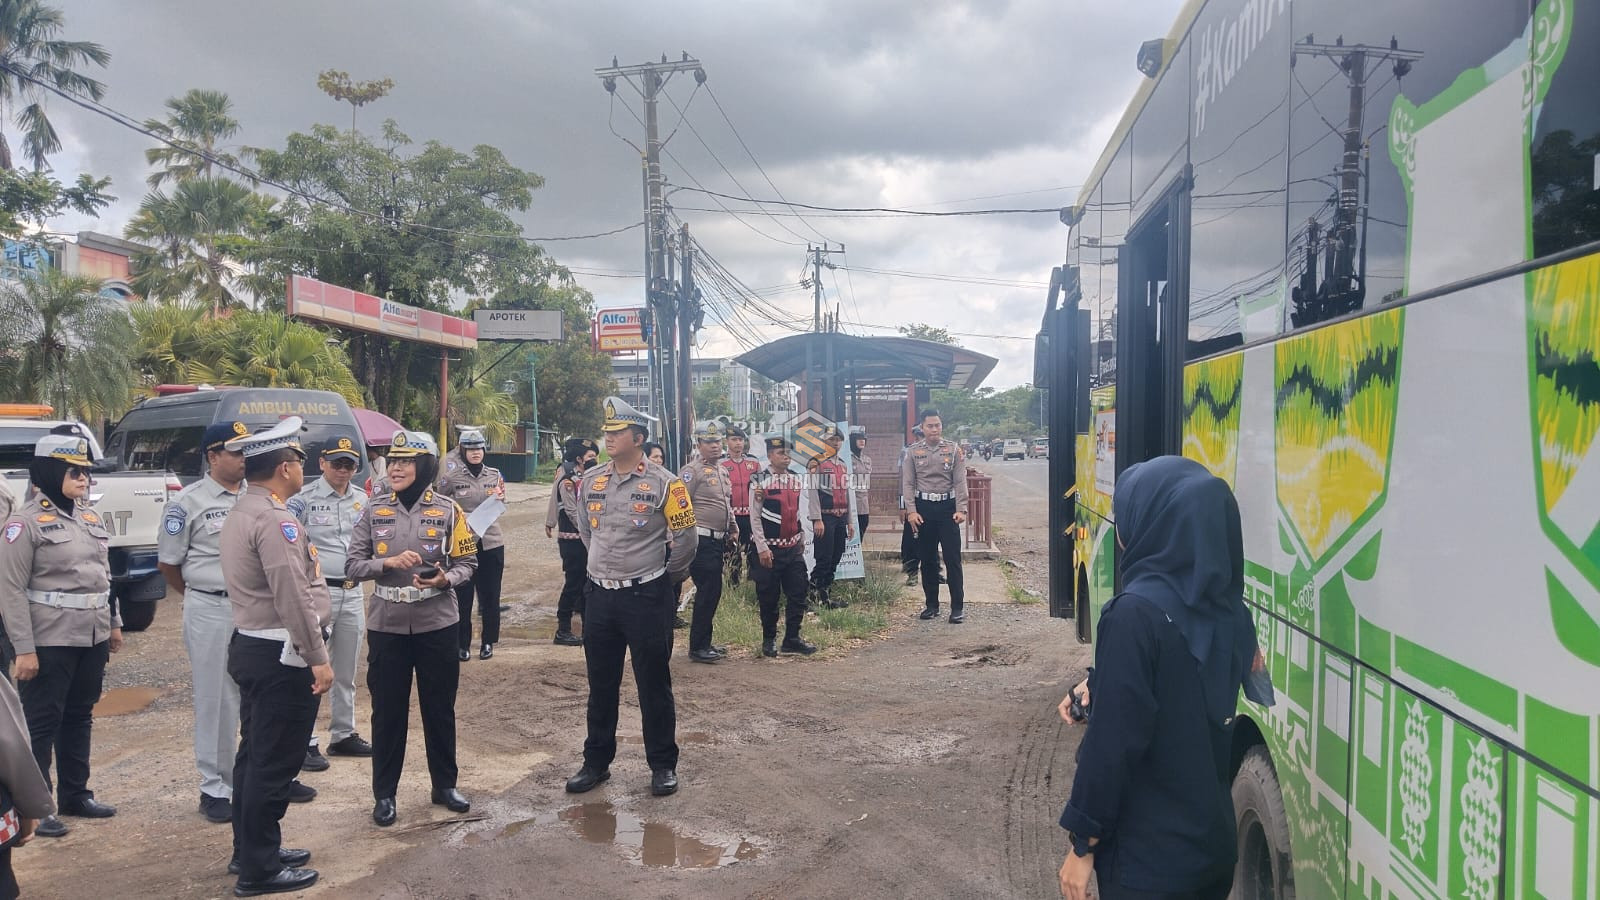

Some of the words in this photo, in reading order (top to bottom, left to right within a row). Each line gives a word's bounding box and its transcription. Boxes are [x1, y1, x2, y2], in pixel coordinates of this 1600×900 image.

[1195, 0, 1285, 138] #Kami
[489, 312, 527, 321] APOTEK
[238, 401, 339, 416] AMBULANCE
[420, 518, 445, 527] POLRI
